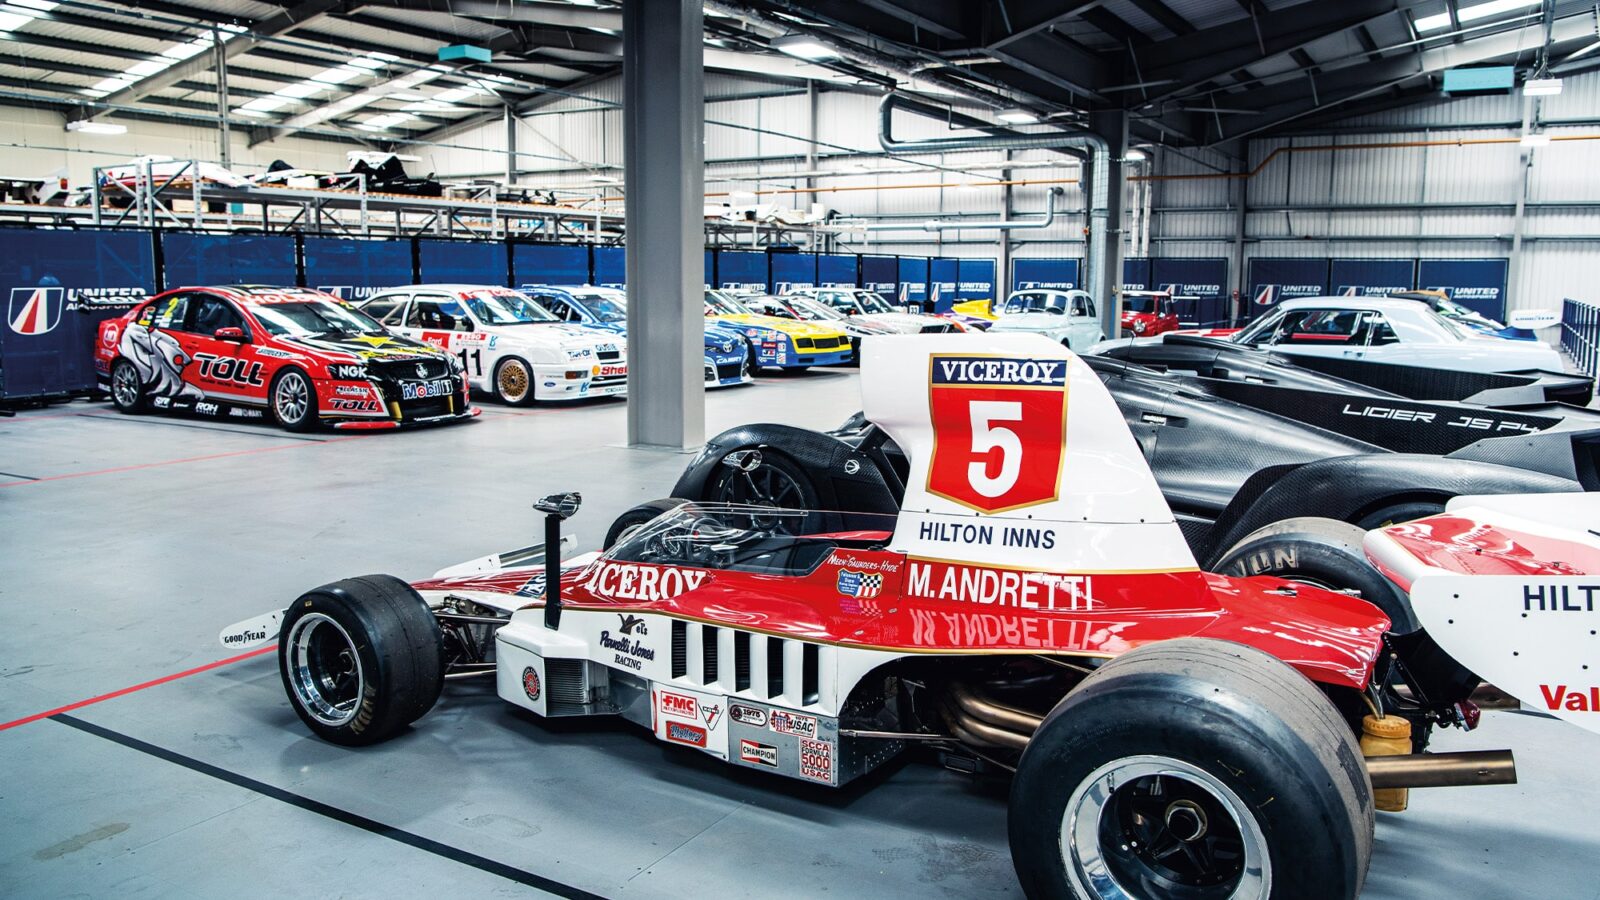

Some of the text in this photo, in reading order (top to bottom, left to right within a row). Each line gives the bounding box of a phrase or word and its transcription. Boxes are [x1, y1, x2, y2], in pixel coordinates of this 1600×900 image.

[1454, 287, 1500, 295] UNITED
[193, 352, 264, 388] TOLL
[457, 348, 483, 376] 11
[339, 365, 369, 379] NGK
[940, 360, 1058, 384] VICEROY
[402, 382, 441, 401] Mobil
[195, 401, 219, 412] ROH
[329, 398, 379, 412] TOLL
[1342, 404, 1437, 423] LIGIER
[1447, 416, 1494, 430] JS
[967, 400, 1023, 497] 5
[919, 521, 1056, 549] HILTON INNS
[630, 640, 655, 661] Jones
[614, 654, 642, 671] RACING
[663, 695, 694, 711] FMC
[742, 746, 775, 760] CHAMPION
[801, 740, 830, 752] SCCA
[801, 747, 830, 759] FORMULA
[801, 753, 830, 770] 5000
[801, 768, 830, 780] USAC
